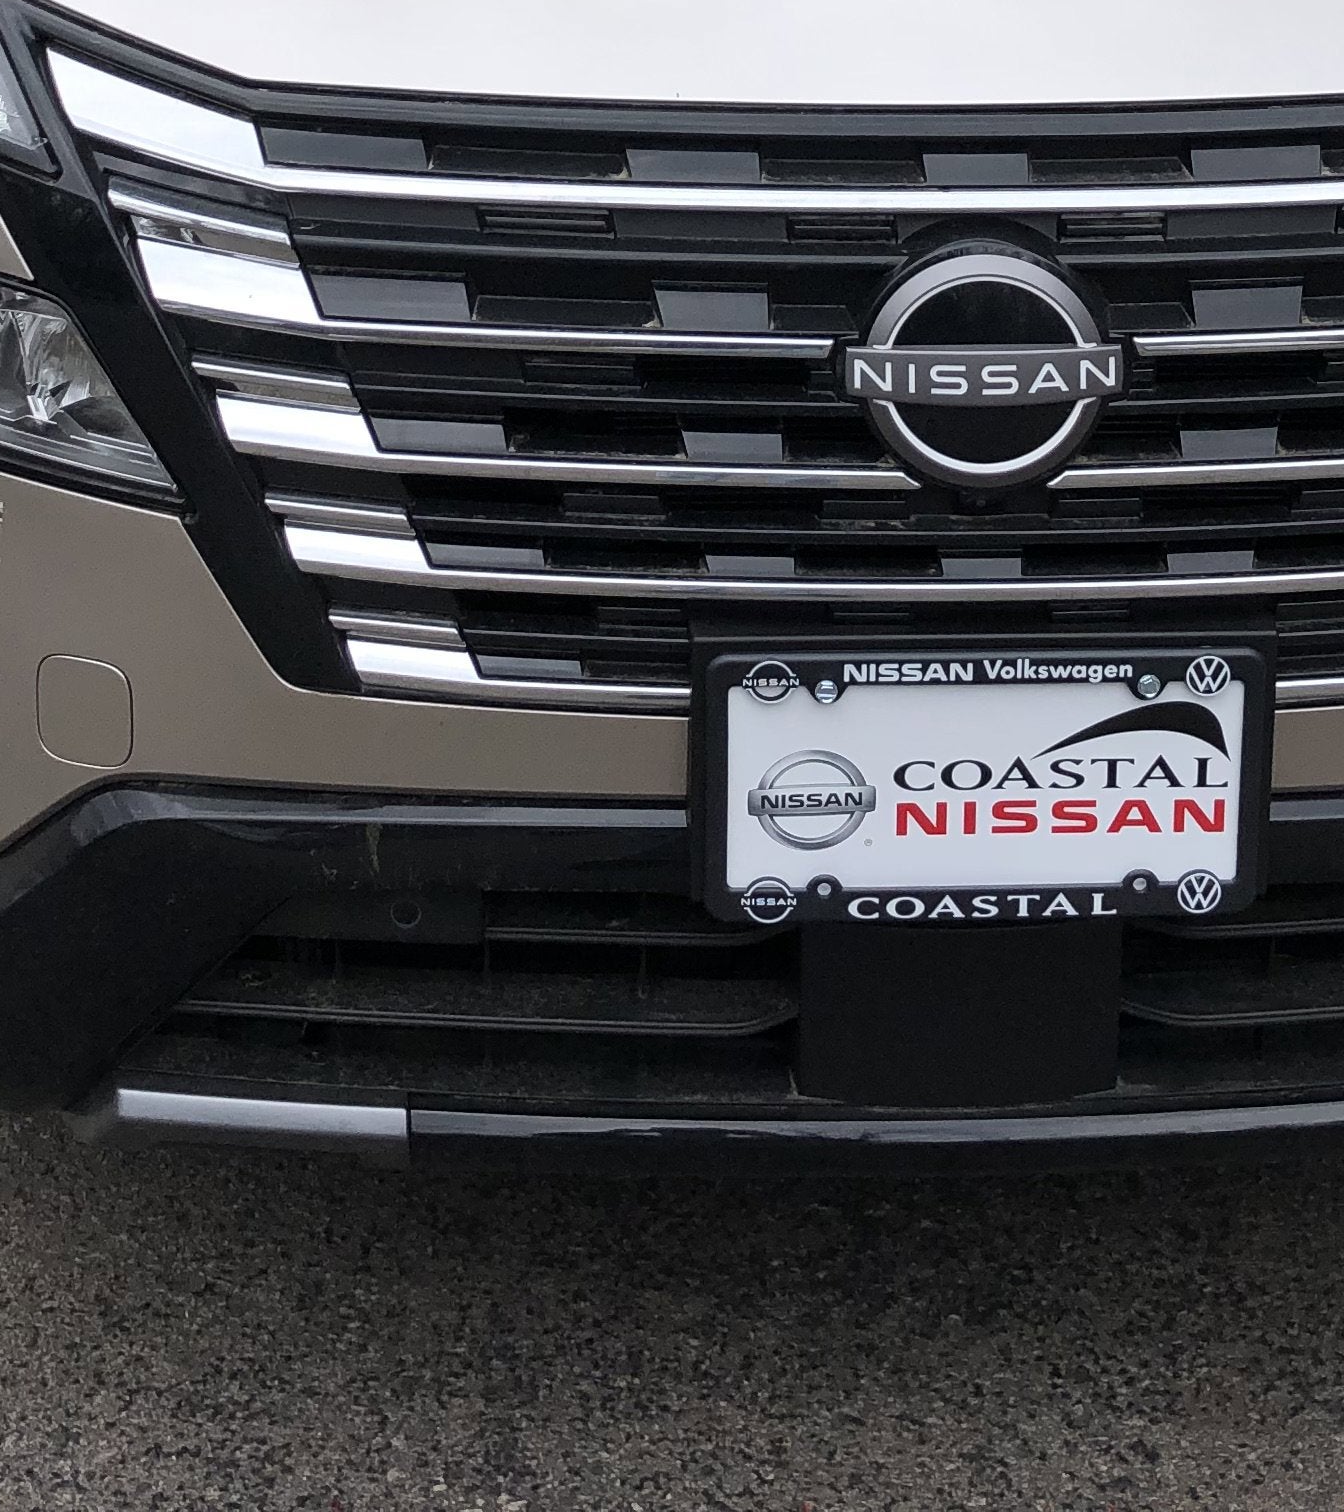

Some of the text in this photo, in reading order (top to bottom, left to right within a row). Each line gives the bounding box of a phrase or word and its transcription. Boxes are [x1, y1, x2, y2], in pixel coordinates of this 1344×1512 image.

[853, 356, 1116, 396] NISSAN
[742, 678, 800, 687] NISSAN
[843, 659, 1134, 682] NISSAN Volkswagen
[893, 755, 1229, 792] COASTAL
[760, 792, 863, 809] NISSAN
[895, 798, 1225, 836] NISSAN
[740, 897, 797, 906] NISSAN
[847, 893, 1118, 919] COASTAL
